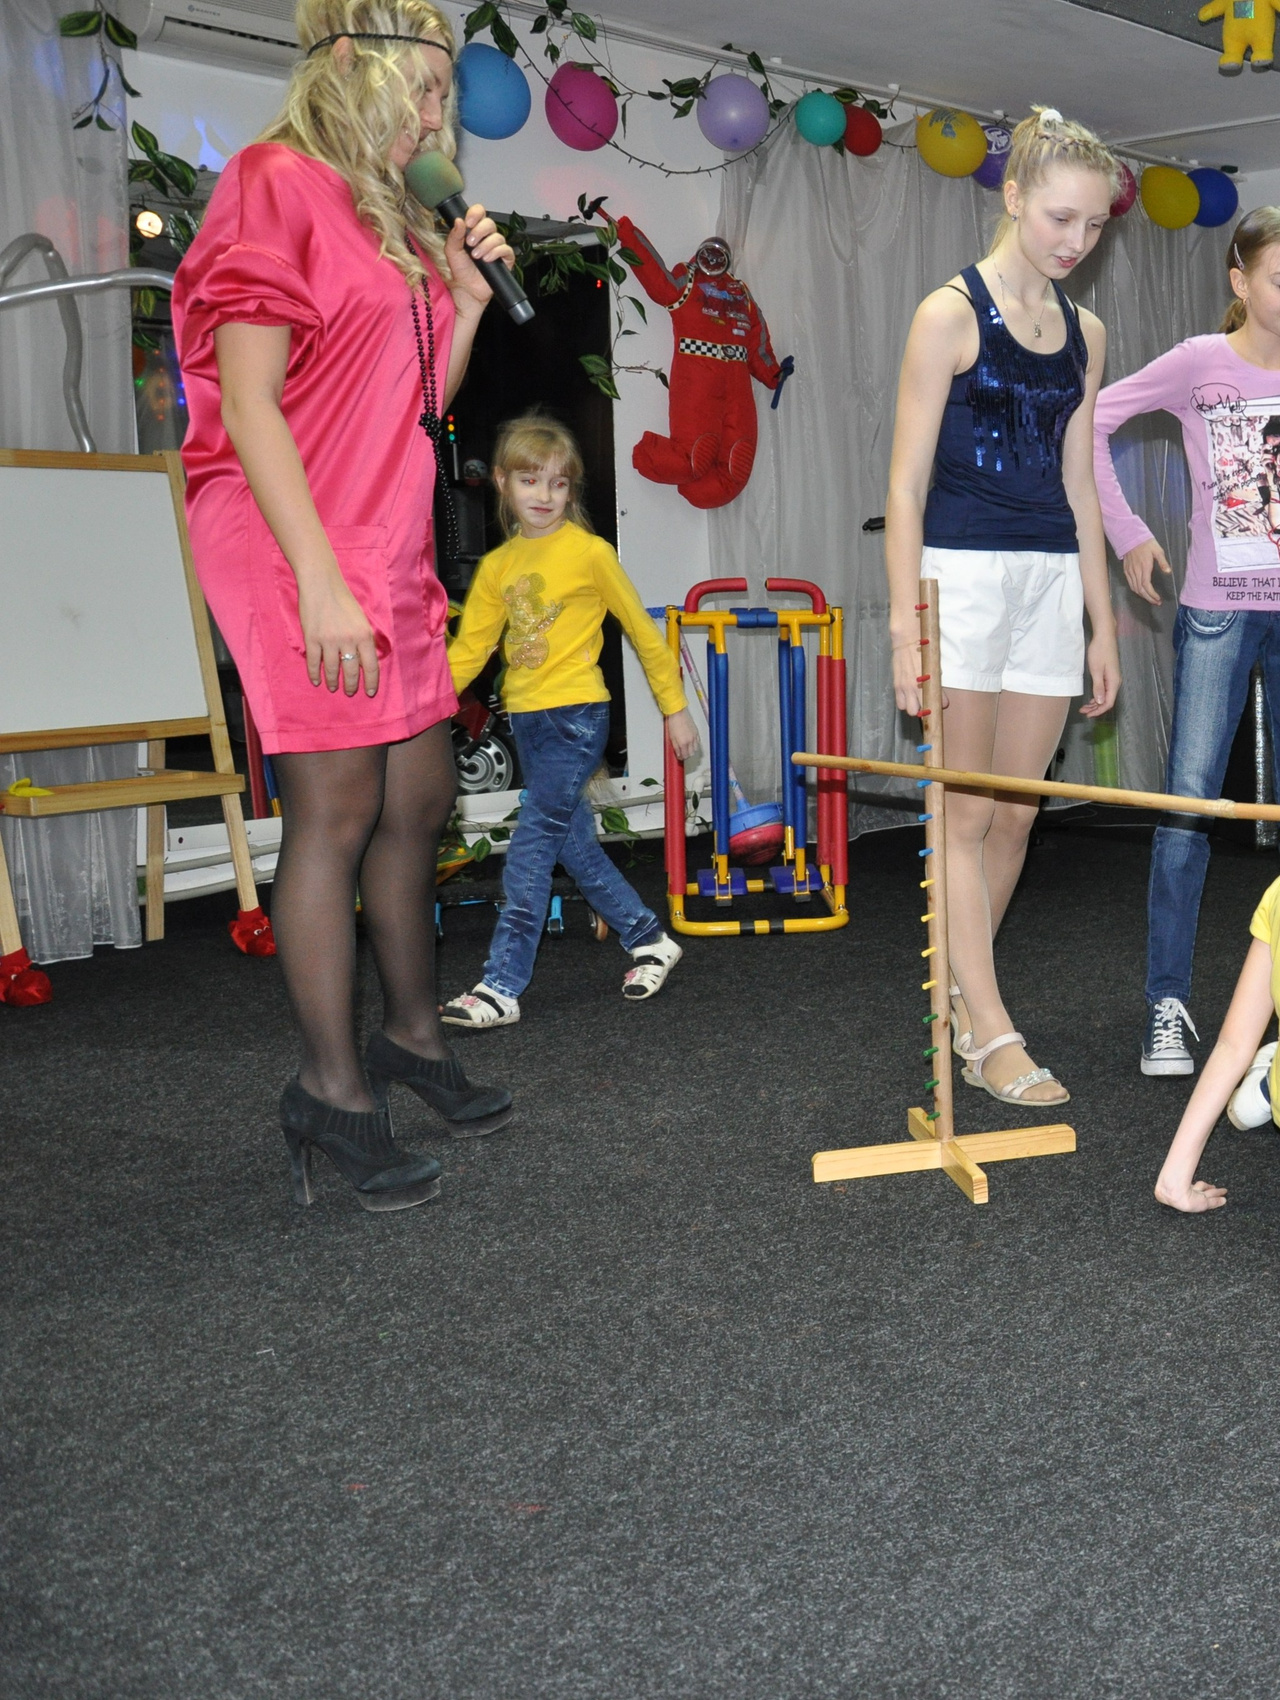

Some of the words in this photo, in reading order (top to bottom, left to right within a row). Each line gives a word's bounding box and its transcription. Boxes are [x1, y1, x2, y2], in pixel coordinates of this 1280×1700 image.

[1212, 576, 1248, 588] BELIEVE
[1251, 577, 1277, 588] THAT
[1226, 591, 1246, 601] KEEP
[1246, 591, 1262, 601] THE
